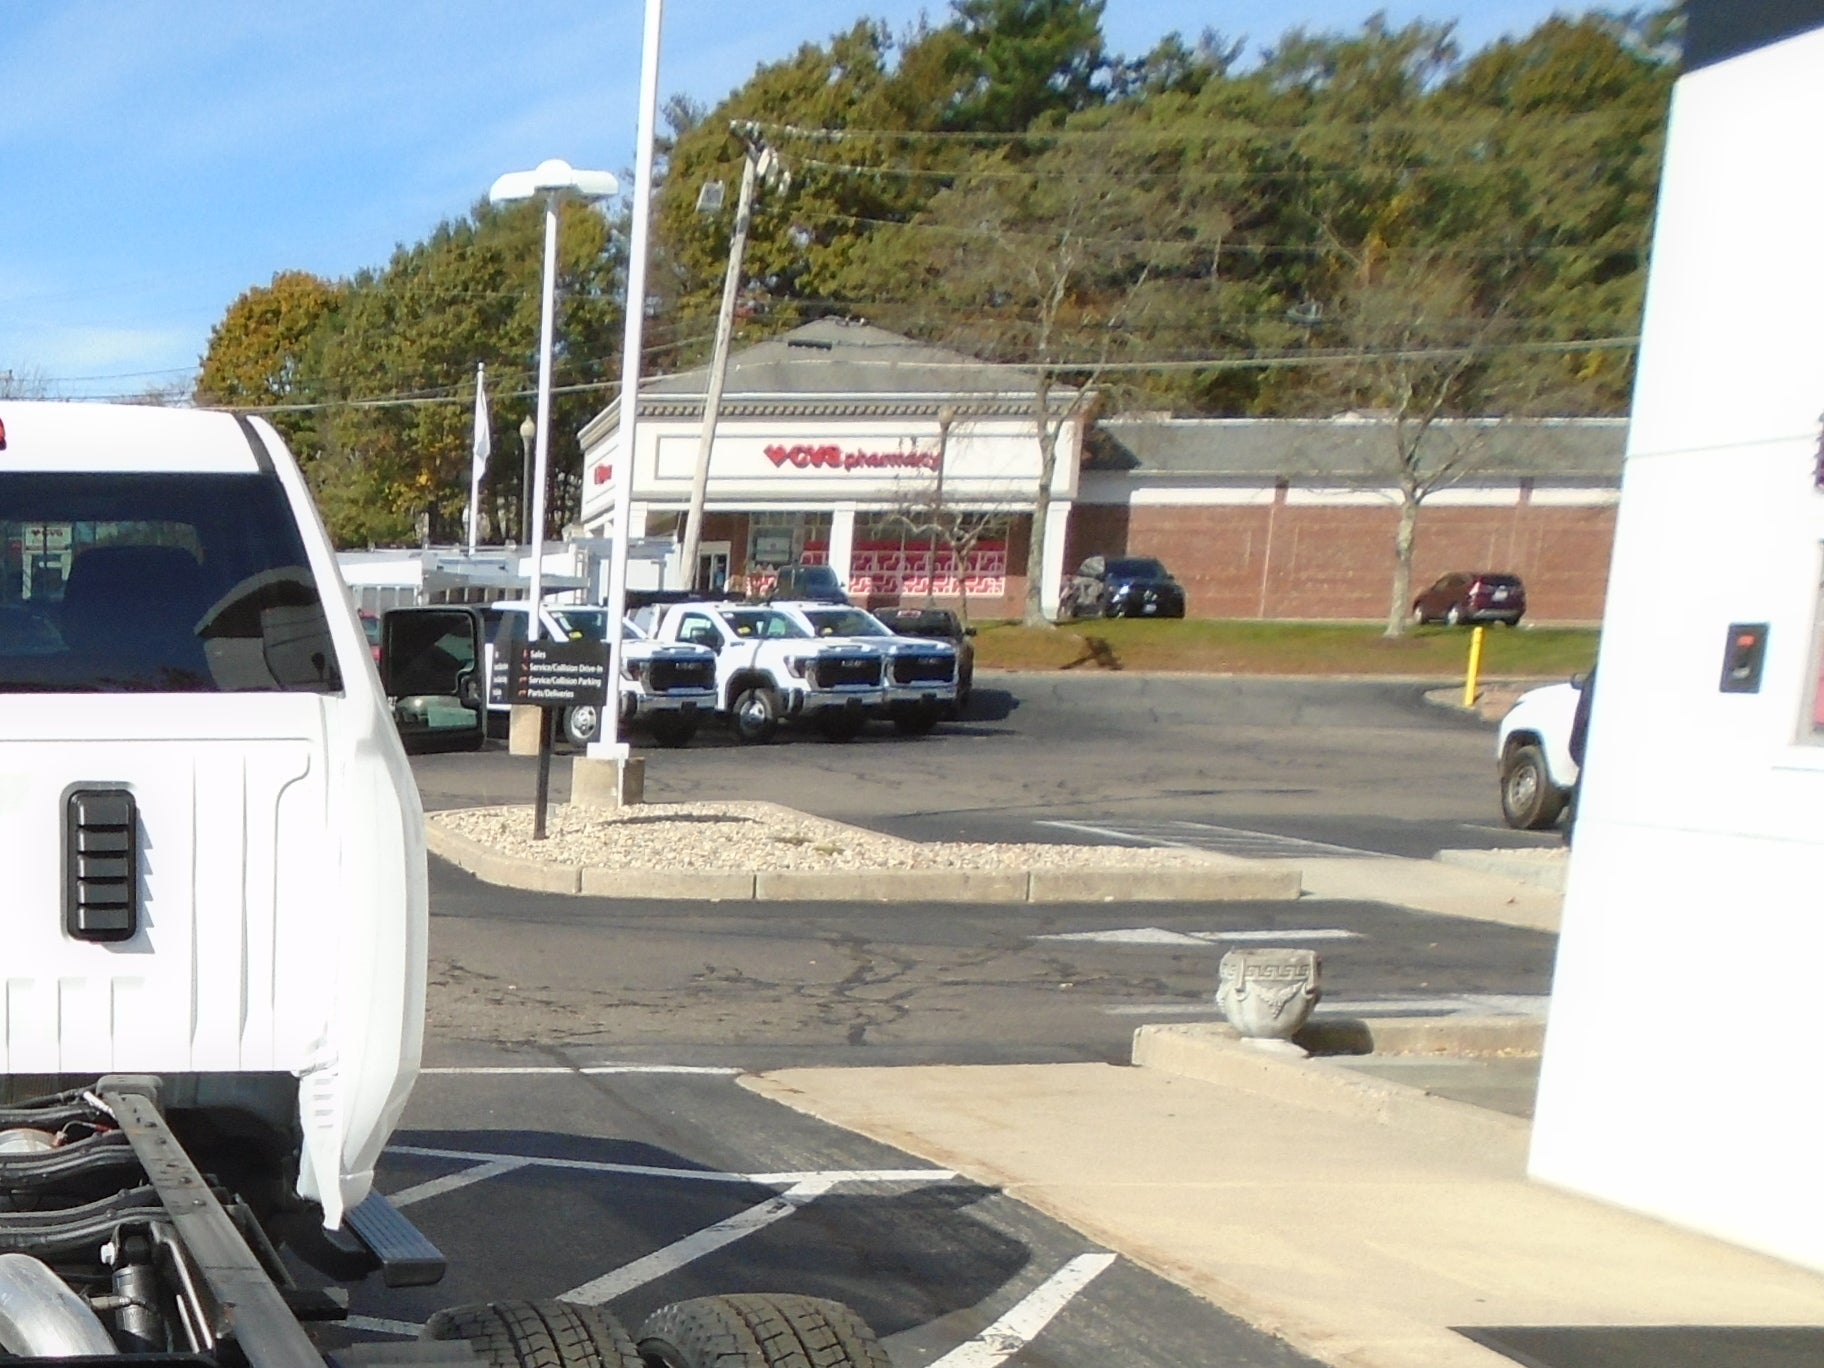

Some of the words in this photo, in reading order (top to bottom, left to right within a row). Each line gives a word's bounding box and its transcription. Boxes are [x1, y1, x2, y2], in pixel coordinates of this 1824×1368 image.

[788, 444, 842, 468] CVS
[530, 650, 546, 659] Sales
[529, 663, 578, 672] Service/Collision
[528, 675, 578, 686] Service/Collision
[578, 678, 602, 687] Parking
[527, 688, 575, 699] Parts/Deliveries
